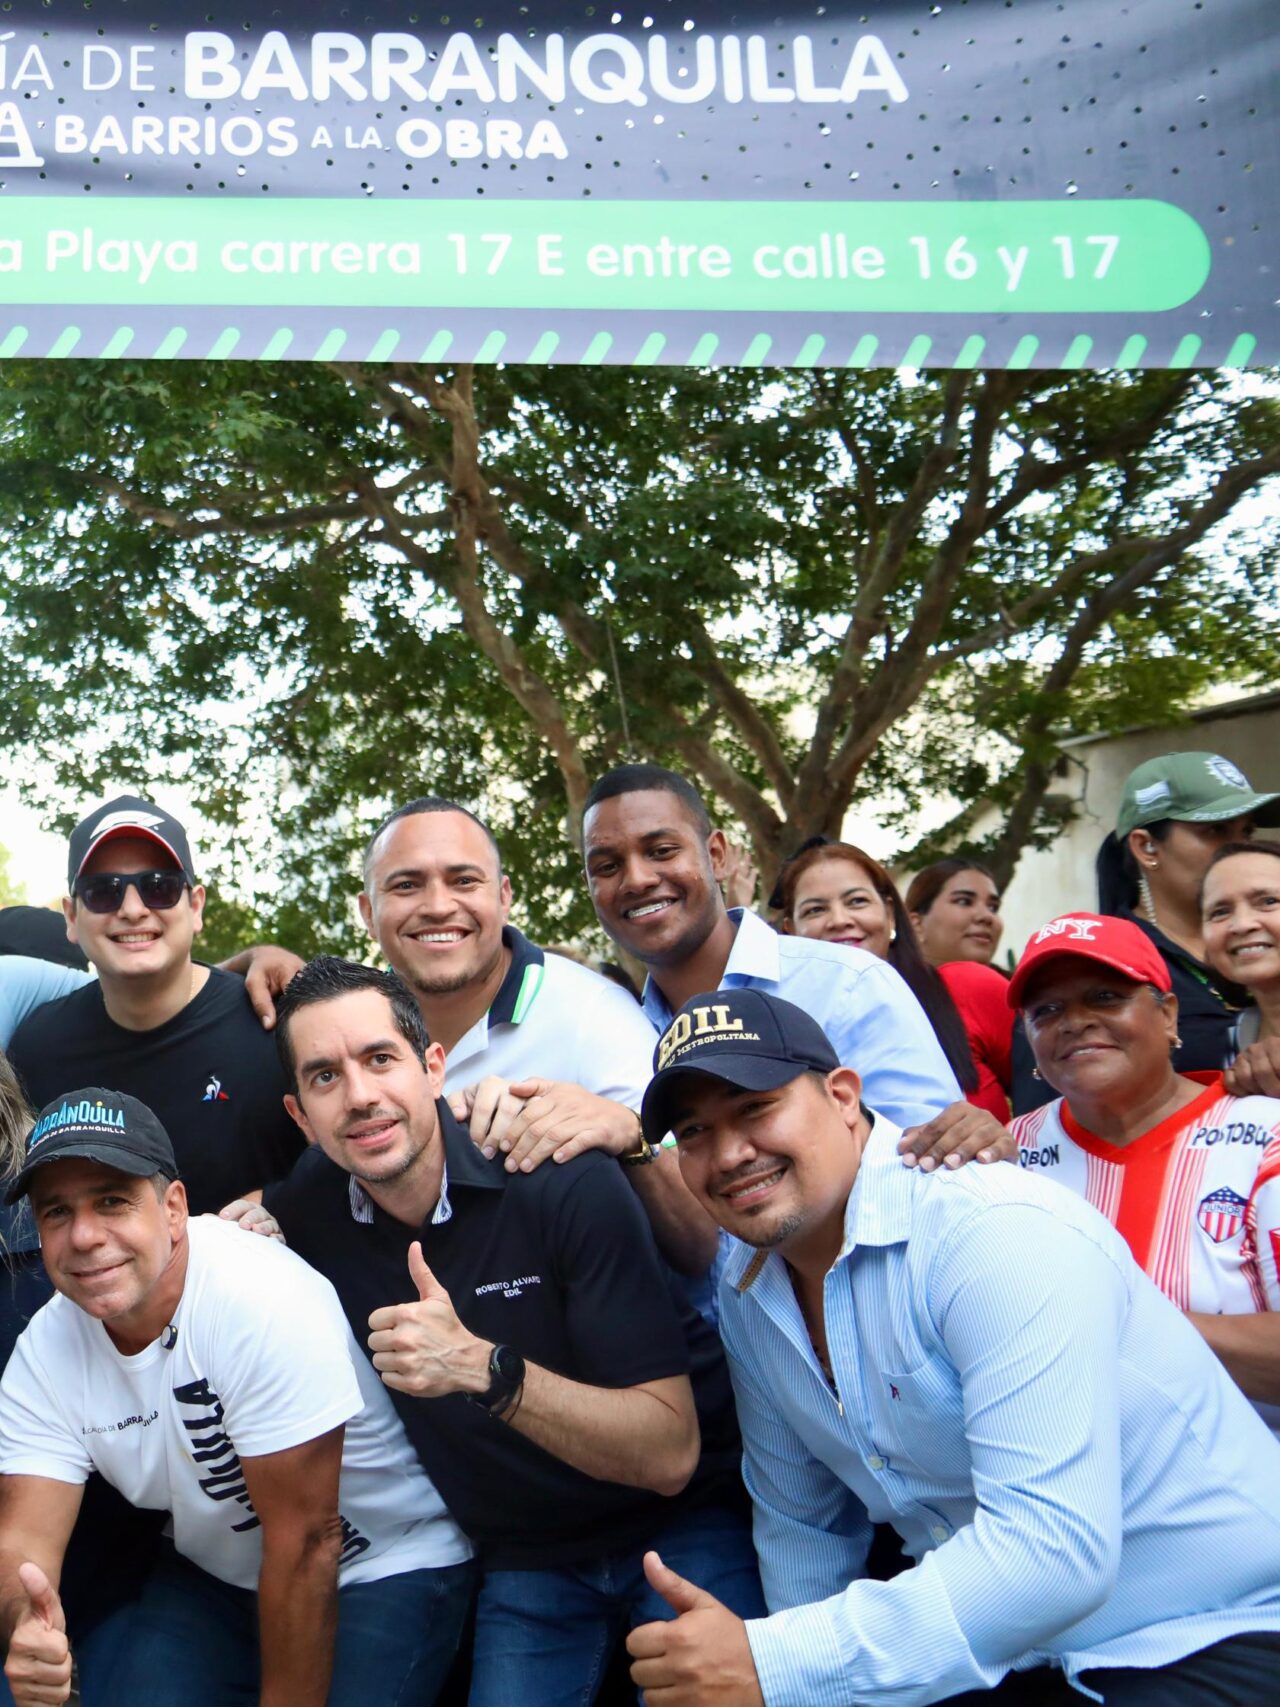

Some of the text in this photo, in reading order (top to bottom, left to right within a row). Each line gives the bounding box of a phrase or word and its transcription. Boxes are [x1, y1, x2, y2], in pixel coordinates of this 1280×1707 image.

[83, 45, 156, 91] DE
[184, 31, 908, 107] BARRANQUILLA
[54, 114, 569, 160] BARRIOS A LA OBRA
[46, 228, 198, 283] Playa
[220, 241, 421, 274] carrera
[448, 233, 513, 275] 17
[537, 234, 564, 276] E
[586, 236, 731, 277] entre
[753, 235, 886, 279] calle
[908, 235, 978, 281] 16
[996, 245, 1029, 292] y
[1051, 234, 1119, 279] 17
[1034, 917, 1103, 944] NY
[677, 1032, 761, 1056] METROPOLITANA
[58, 1124, 126, 1135] BARRANQUILLA
